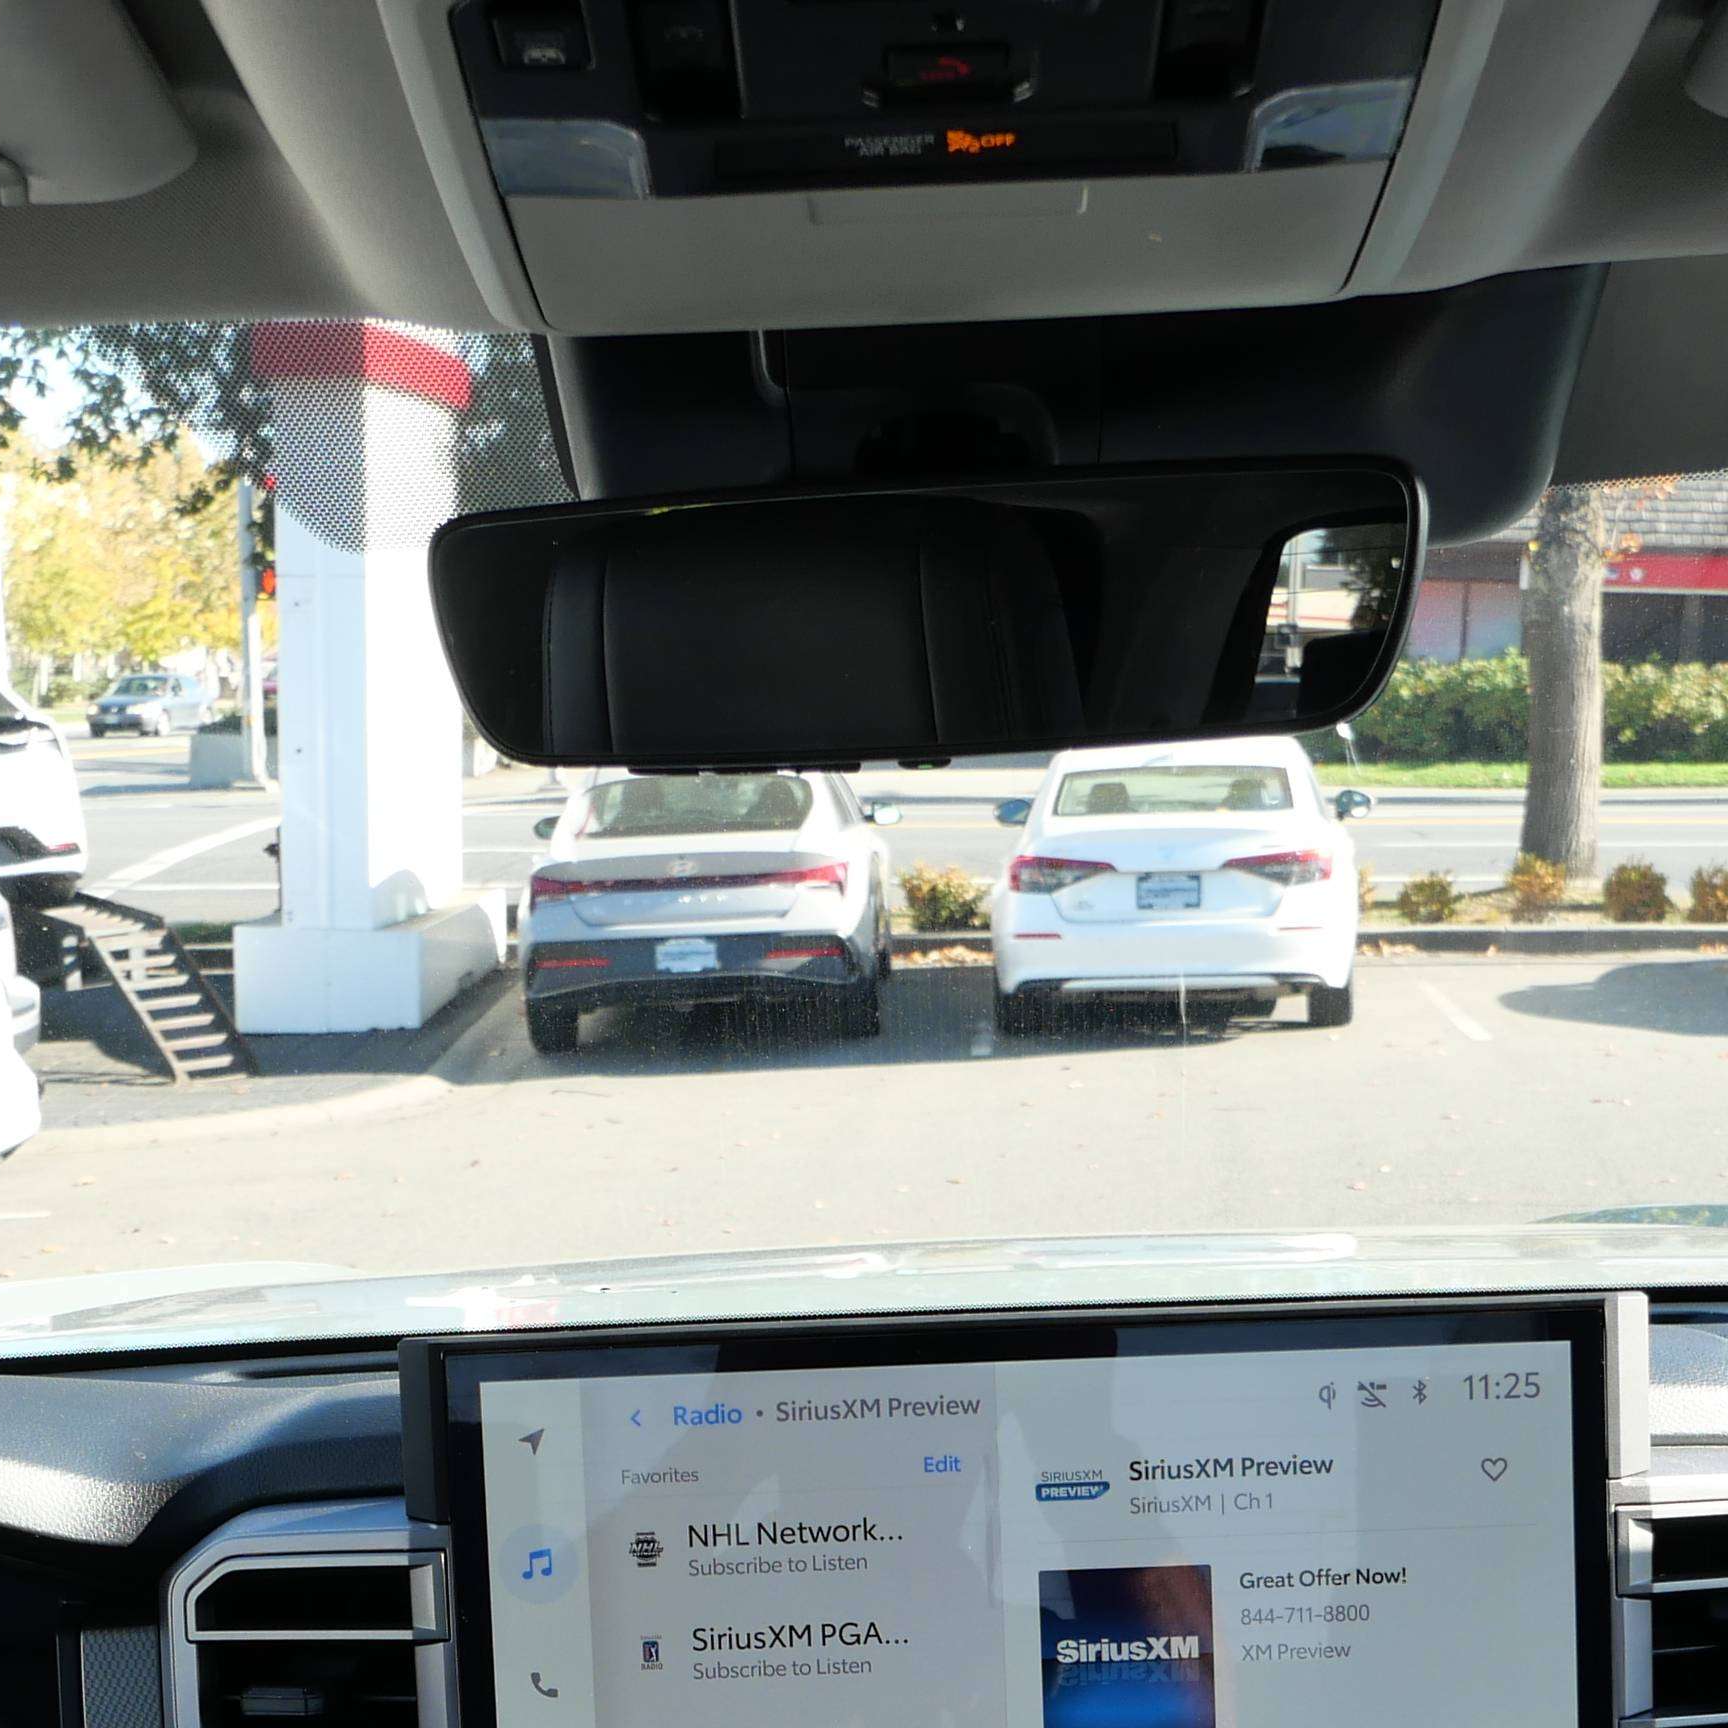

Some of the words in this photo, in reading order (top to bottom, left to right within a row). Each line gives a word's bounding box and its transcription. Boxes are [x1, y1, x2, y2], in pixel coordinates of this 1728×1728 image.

[845, 134, 934, 148] PASSENGER
[981, 133, 1015, 147] OFF
[1463, 1372, 1541, 1401] 11:25
[673, 1405, 742, 1426] Radio
[776, 1398, 881, 1423] SiriusXM
[887, 1396, 981, 1418] Preview
[622, 1467, 699, 1486] Favorites
[923, 1456, 961, 1474] Edit
[1040, 1469, 1103, 1482] SIRIUSXM
[1129, 1458, 1234, 1482] SiriusXM
[1241, 1455, 1334, 1477] Preview
[1041, 1484, 1101, 1499] PREVIEW
[1129, 1494, 1212, 1515] SiriusXM
[1233, 1493, 1261, 1511] Ch
[1265, 1492, 1274, 1510] 1
[688, 1521, 750, 1548] NHL
[757, 1517, 904, 1545] Network...
[688, 1555, 783, 1577] Subscribe
[788, 1556, 808, 1573] to
[812, 1552, 869, 1572] Listen
[1239, 1571, 1295, 1591] Great
[1299, 1569, 1352, 1588] Offer
[1356, 1567, 1408, 1586] Now!
[1240, 1604, 1371, 1626] 844-711-8800
[692, 1624, 813, 1652] SiriusXM
[820, 1621, 909, 1648] PGA...
[1056, 1635, 1200, 1664] SiriusXM
[1241, 1643, 1274, 1662] XM
[1277, 1641, 1351, 1660] Preview
[693, 1659, 787, 1681] Subscribe
[792, 1660, 812, 1677] to
[816, 1656, 873, 1676] Listen
